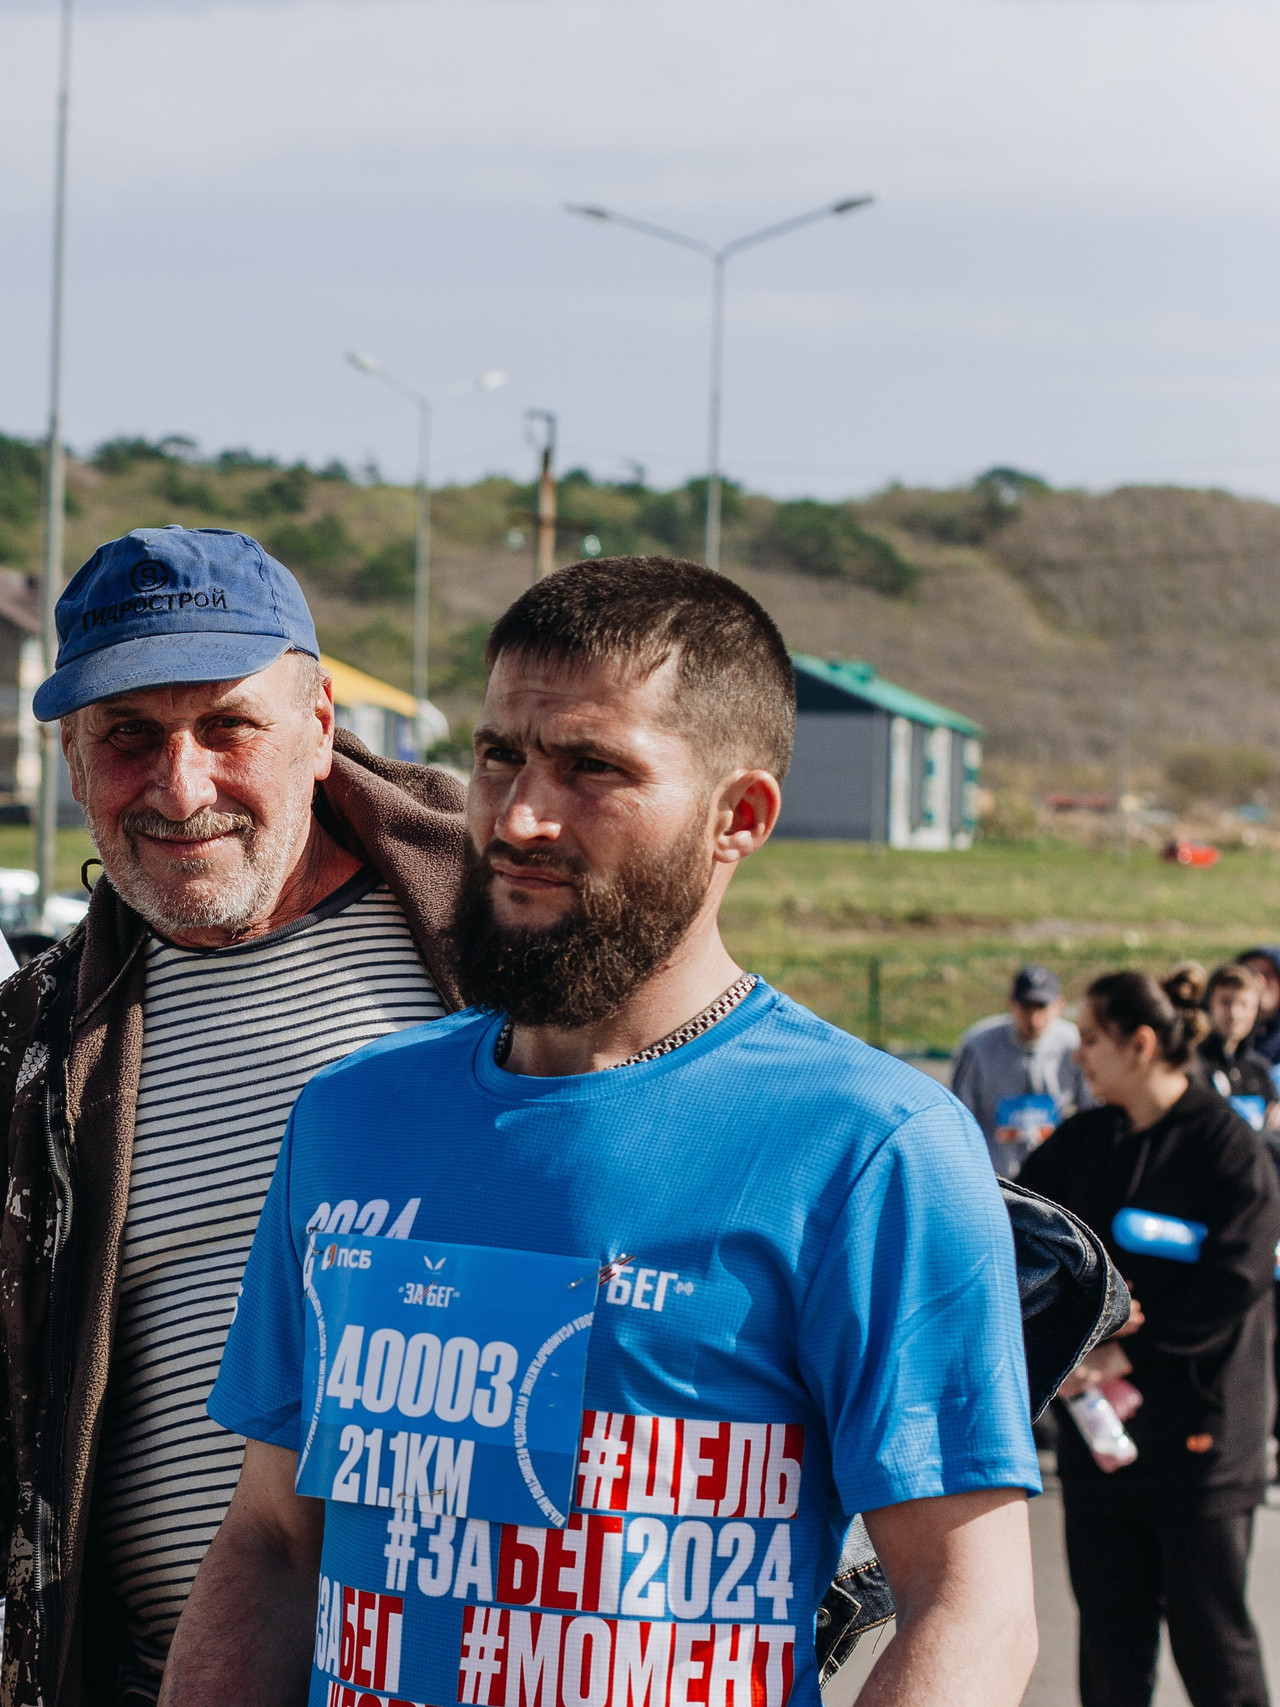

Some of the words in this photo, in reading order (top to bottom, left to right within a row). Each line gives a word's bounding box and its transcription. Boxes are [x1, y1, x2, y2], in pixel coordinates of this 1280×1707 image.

[82, 587, 228, 633] ГИДРОСТРОЙ
[337, 1248, 372, 1269] ПСБ
[326, 1324, 519, 1428] 40003
[577, 1409, 804, 1519] #ЦЕЛЬ
[314, 1574, 403, 1694] ЗАБЕГ
[457, 1605, 797, 1707] #МОМЕНТ
